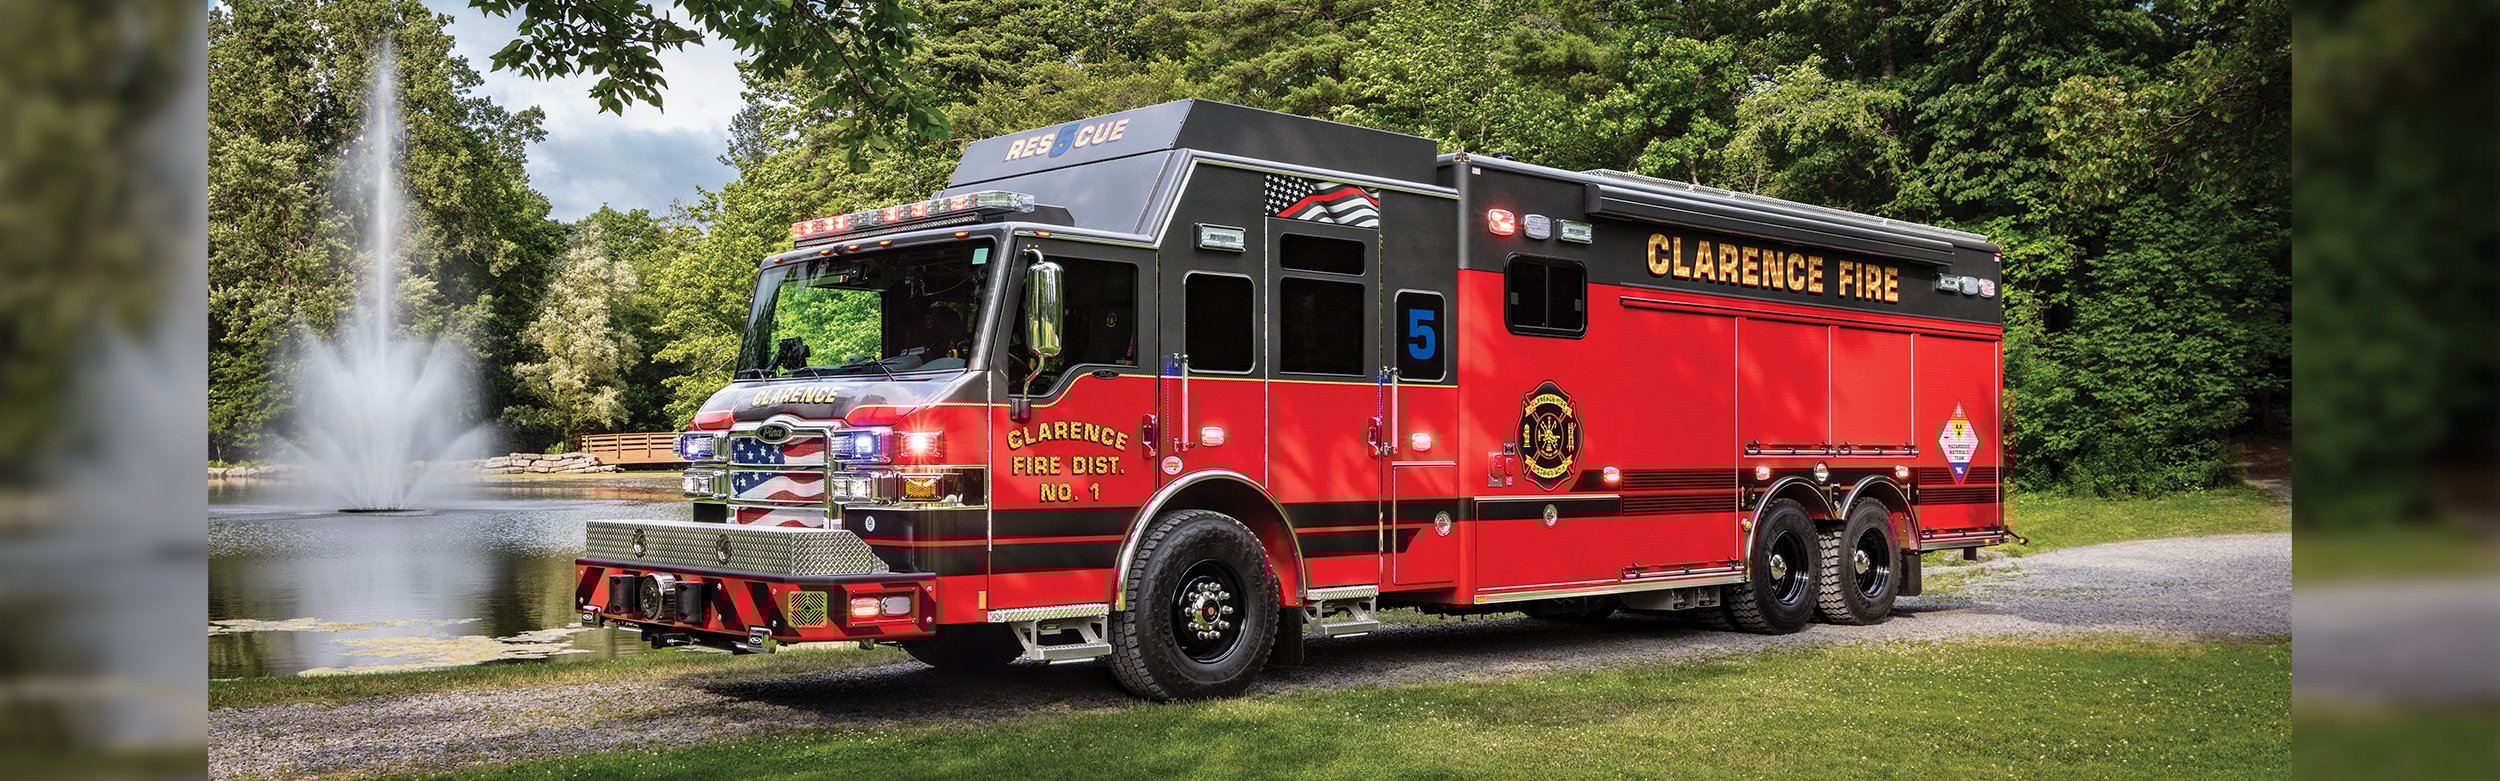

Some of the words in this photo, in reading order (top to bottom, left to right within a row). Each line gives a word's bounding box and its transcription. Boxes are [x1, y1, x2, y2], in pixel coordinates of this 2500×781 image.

[1646, 233, 1824, 294] CLARENCE
[1837, 259, 1899, 303] FIRE
[1408, 308, 1436, 360] 5
[752, 386, 841, 407] CLARENCE
[1007, 421, 1129, 452] CLARENCE
[1012, 456, 1061, 475] FIRE
[1072, 456, 1125, 475] DIST.
[1040, 483, 1079, 502] NO.
[1088, 483, 1100, 502] 1
